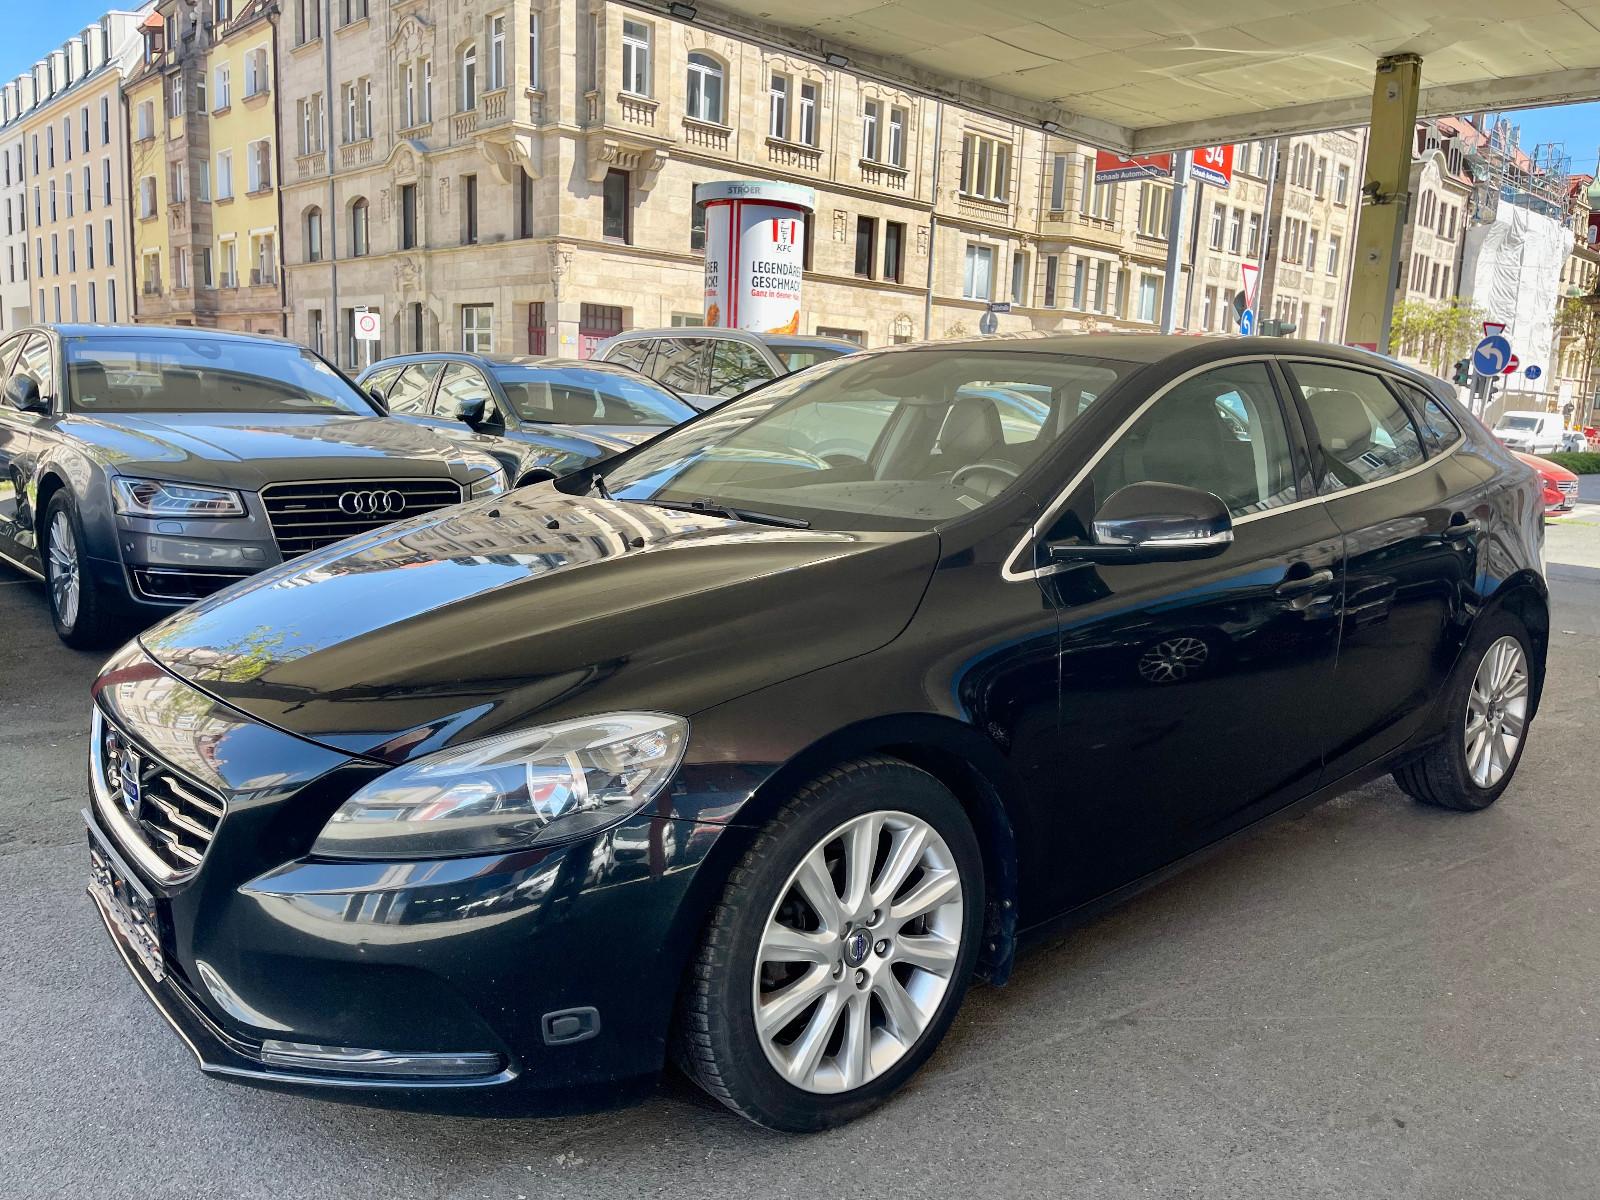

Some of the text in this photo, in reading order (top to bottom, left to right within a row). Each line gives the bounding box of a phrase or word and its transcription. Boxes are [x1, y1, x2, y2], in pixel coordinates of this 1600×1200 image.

[1096, 172, 1119, 182] Schaab
[776, 244, 792, 253] KFC
[751, 289, 768, 298] Ganz
[769, 289, 775, 297] in
